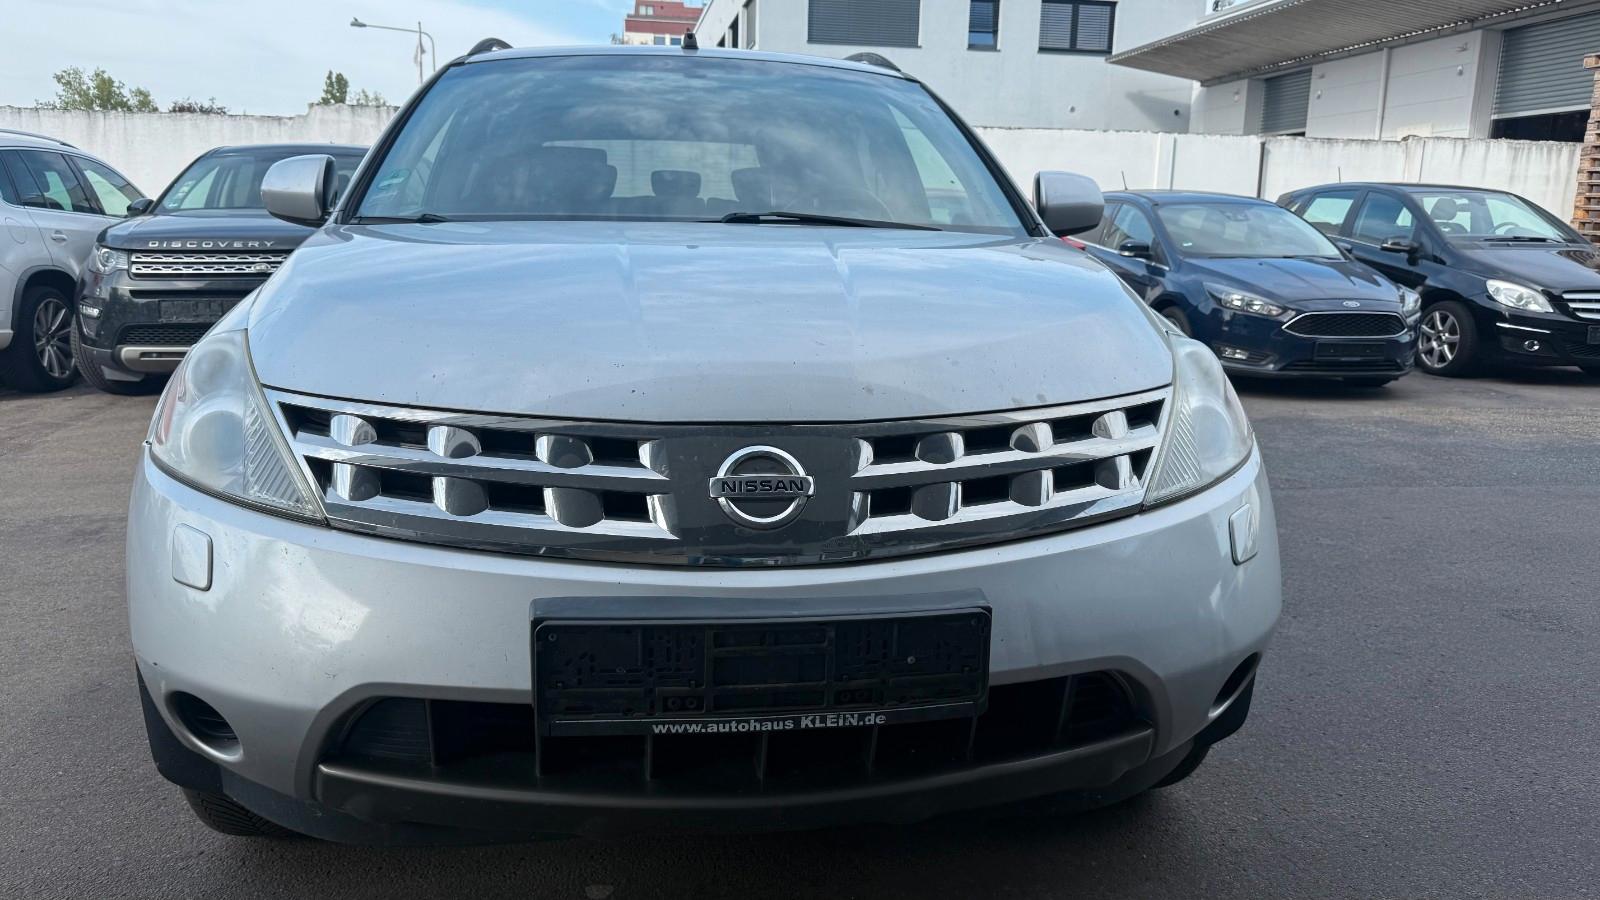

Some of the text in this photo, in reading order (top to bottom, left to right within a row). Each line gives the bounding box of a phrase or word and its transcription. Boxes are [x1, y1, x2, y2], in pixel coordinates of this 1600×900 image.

[149, 240, 275, 248] DISCOVERY
[721, 479, 804, 493] NISSAN
[652, 719, 794, 734] www.autohaus
